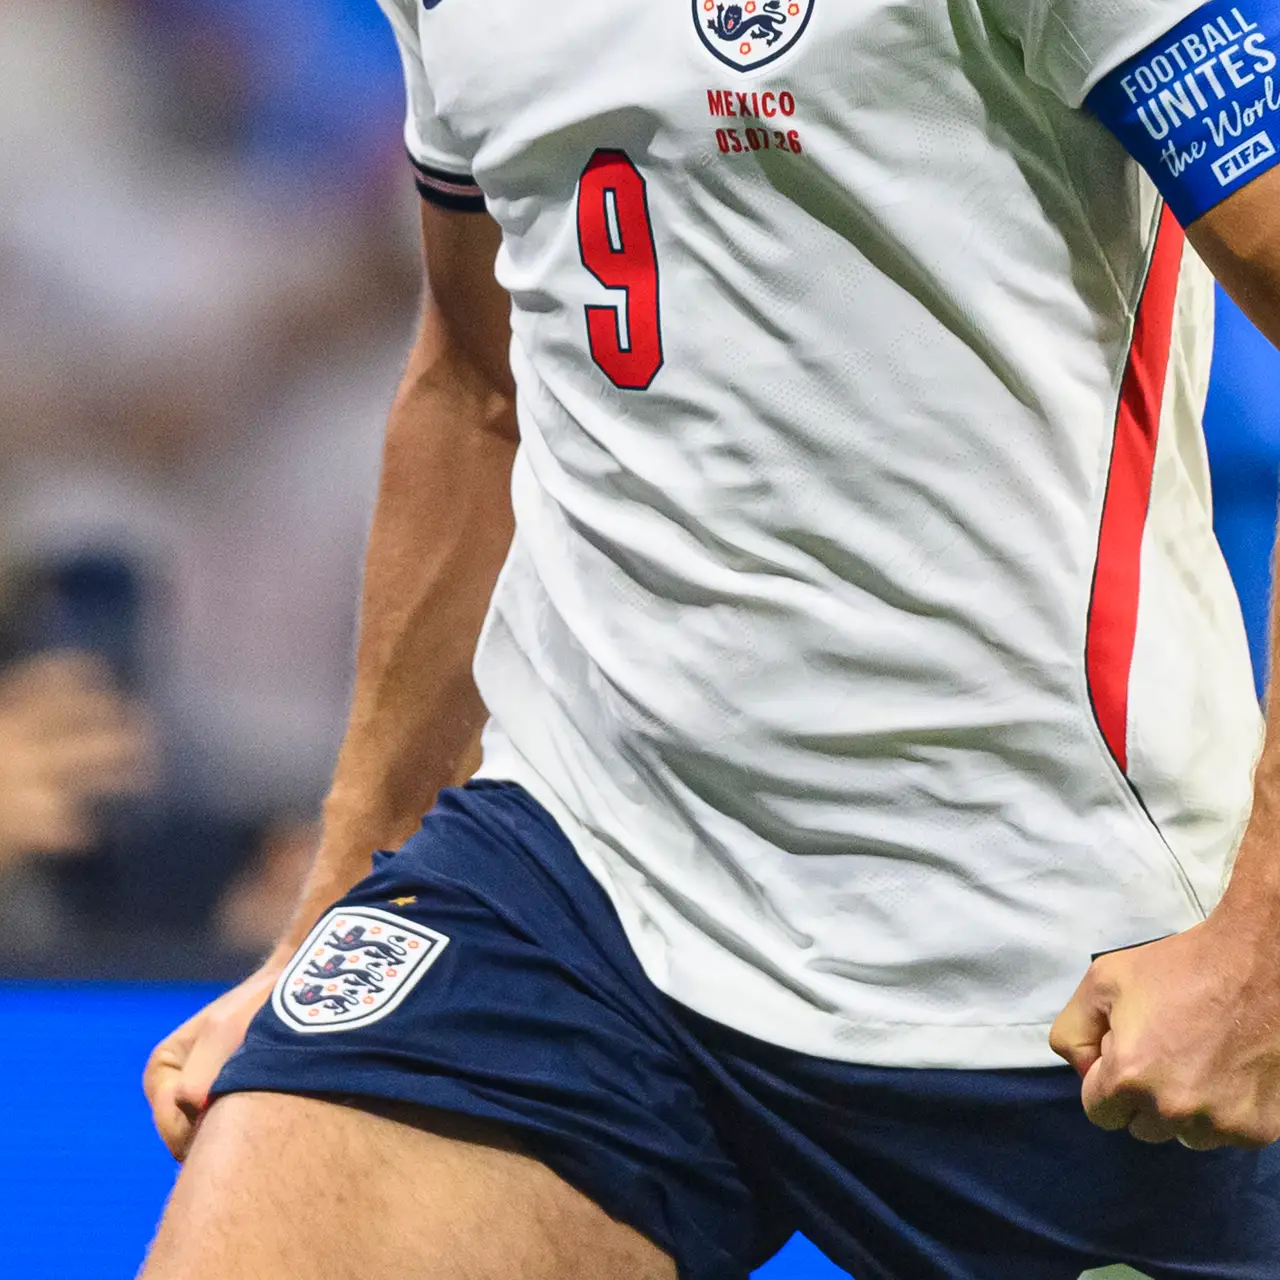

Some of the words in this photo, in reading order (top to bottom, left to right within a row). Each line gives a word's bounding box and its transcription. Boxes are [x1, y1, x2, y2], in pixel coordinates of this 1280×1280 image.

[1120, 7, 1258, 105] FOOTBALL
[706, 88, 795, 118] MEXICO
[1136, 32, 1277, 141] UNITES
[715, 127, 802, 154] 05.0726
[1158, 139, 1207, 178] the
[1215, 135, 1272, 182] FIFA
[576, 147, 664, 391] 9
